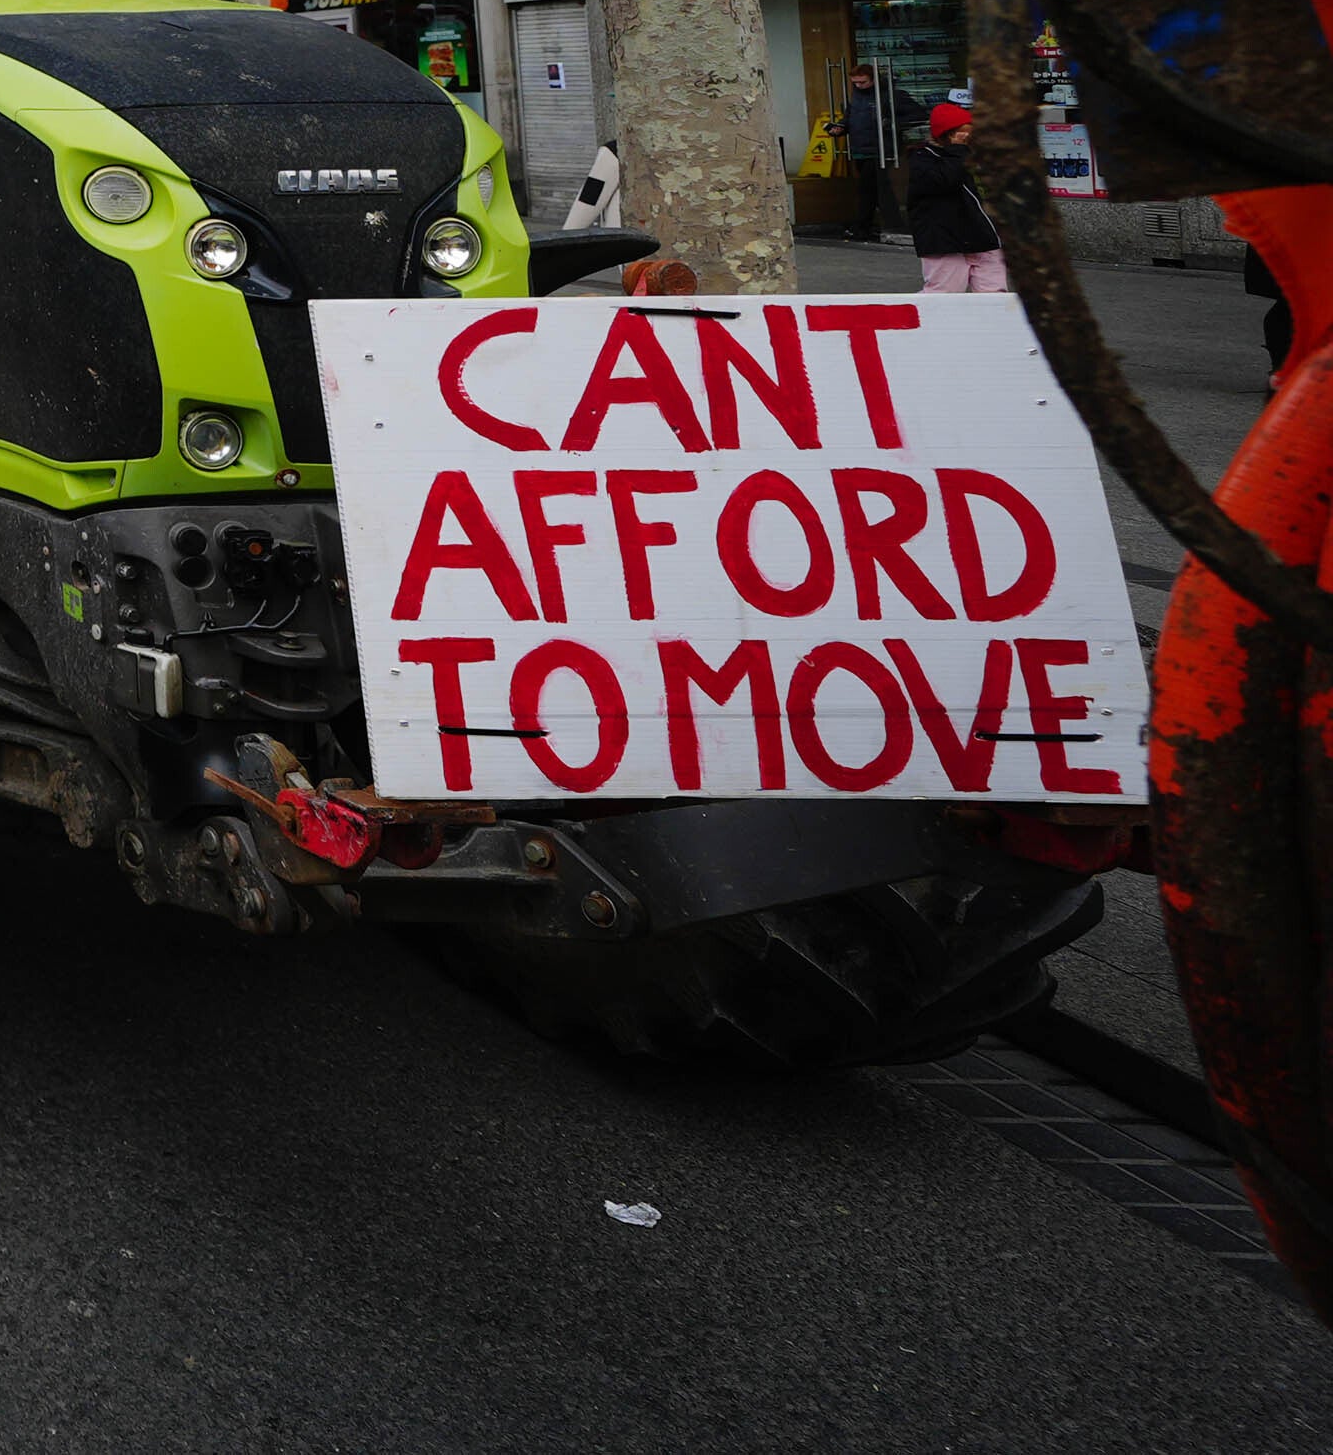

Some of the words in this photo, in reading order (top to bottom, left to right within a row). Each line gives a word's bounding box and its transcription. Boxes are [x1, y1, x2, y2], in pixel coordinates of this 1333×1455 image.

[278, 169, 400, 192] CLAAS
[437, 303, 921, 453] CANT
[390, 468, 1057, 624] AFFORD
[398, 637, 630, 793] TO
[657, 638, 1121, 794] MOVE
